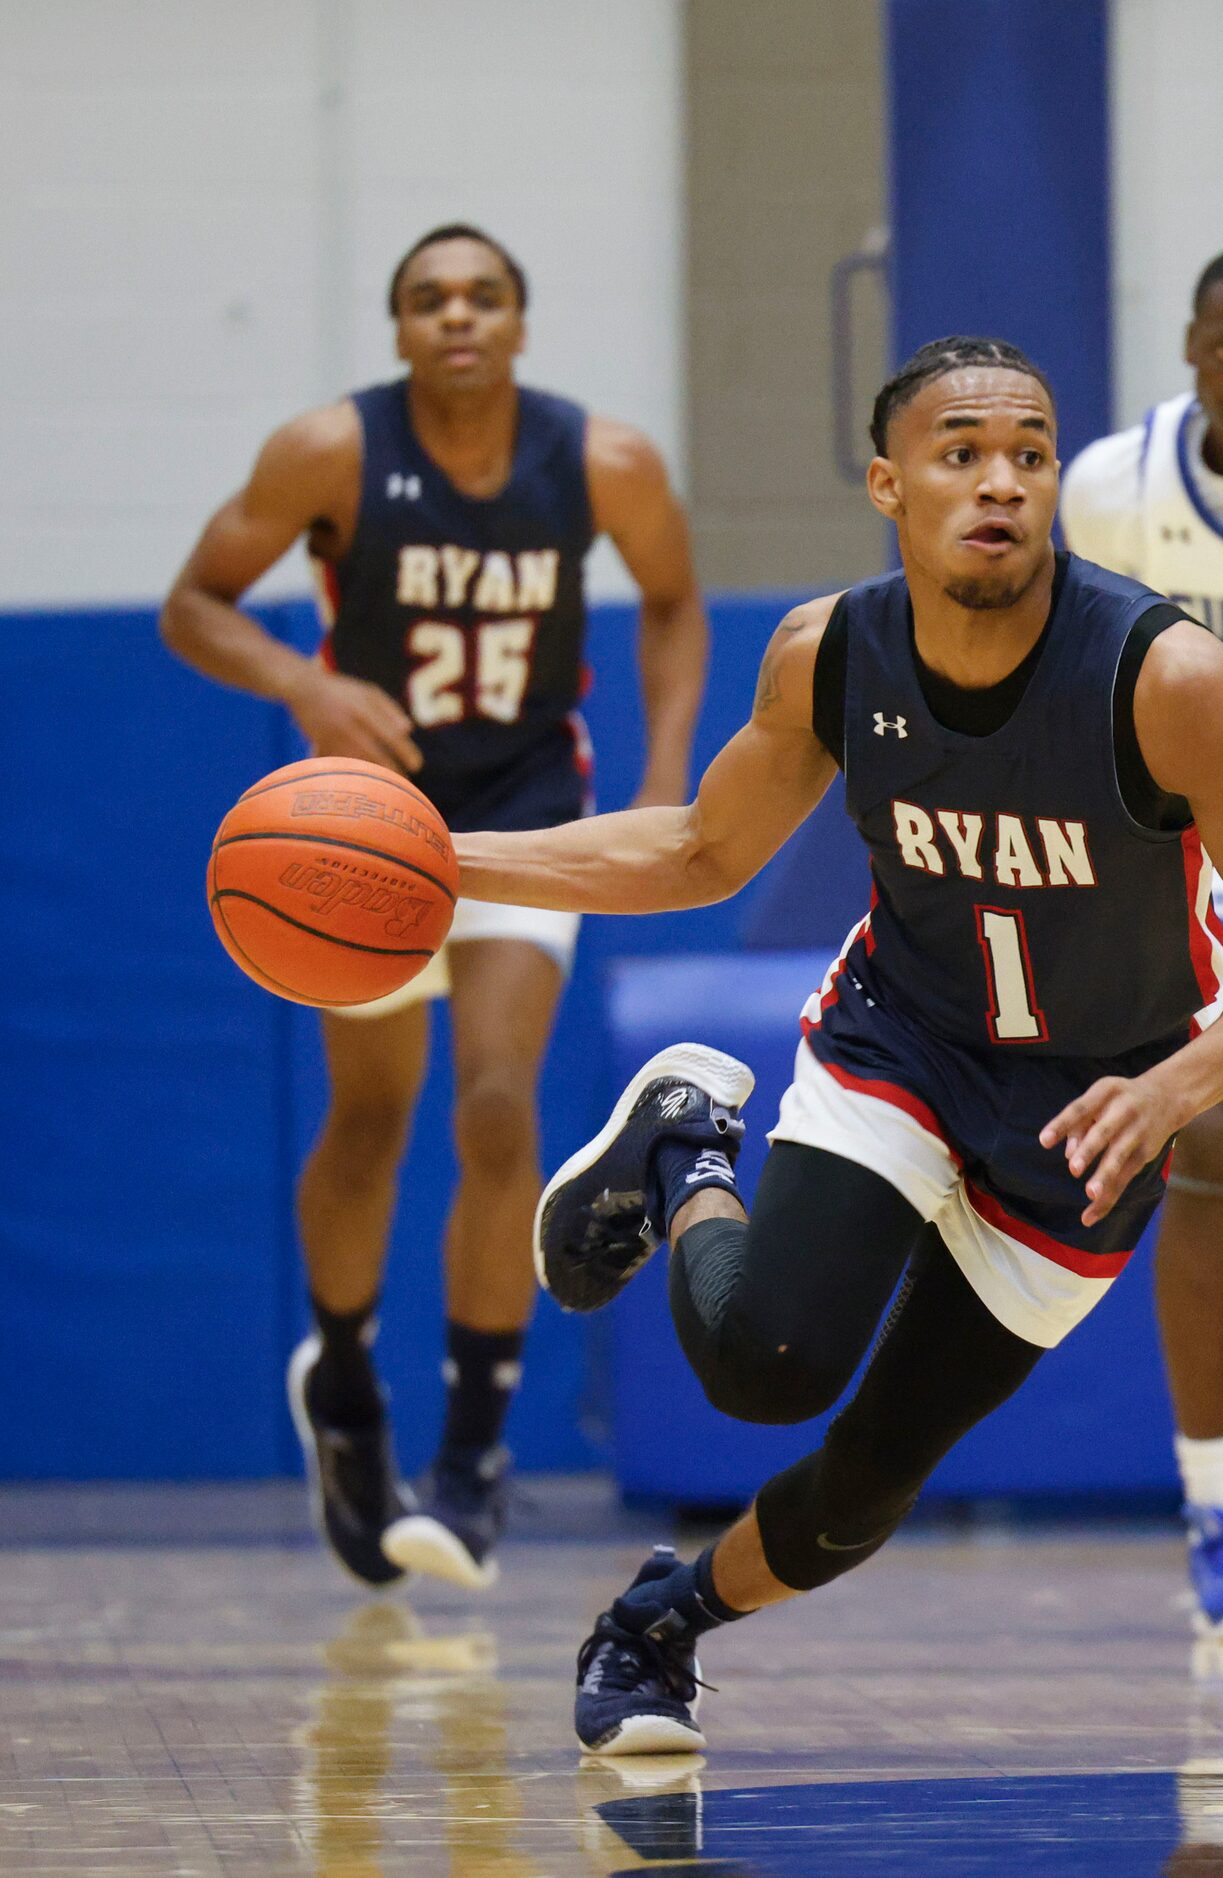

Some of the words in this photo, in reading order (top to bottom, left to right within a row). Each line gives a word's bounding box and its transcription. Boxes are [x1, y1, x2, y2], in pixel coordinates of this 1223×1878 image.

[398, 545, 559, 612] RYAN
[406, 620, 535, 727] 25
[891, 799, 1098, 888] RYAN
[277, 862, 434, 938] Baden
[974, 904, 1049, 1044] 1
